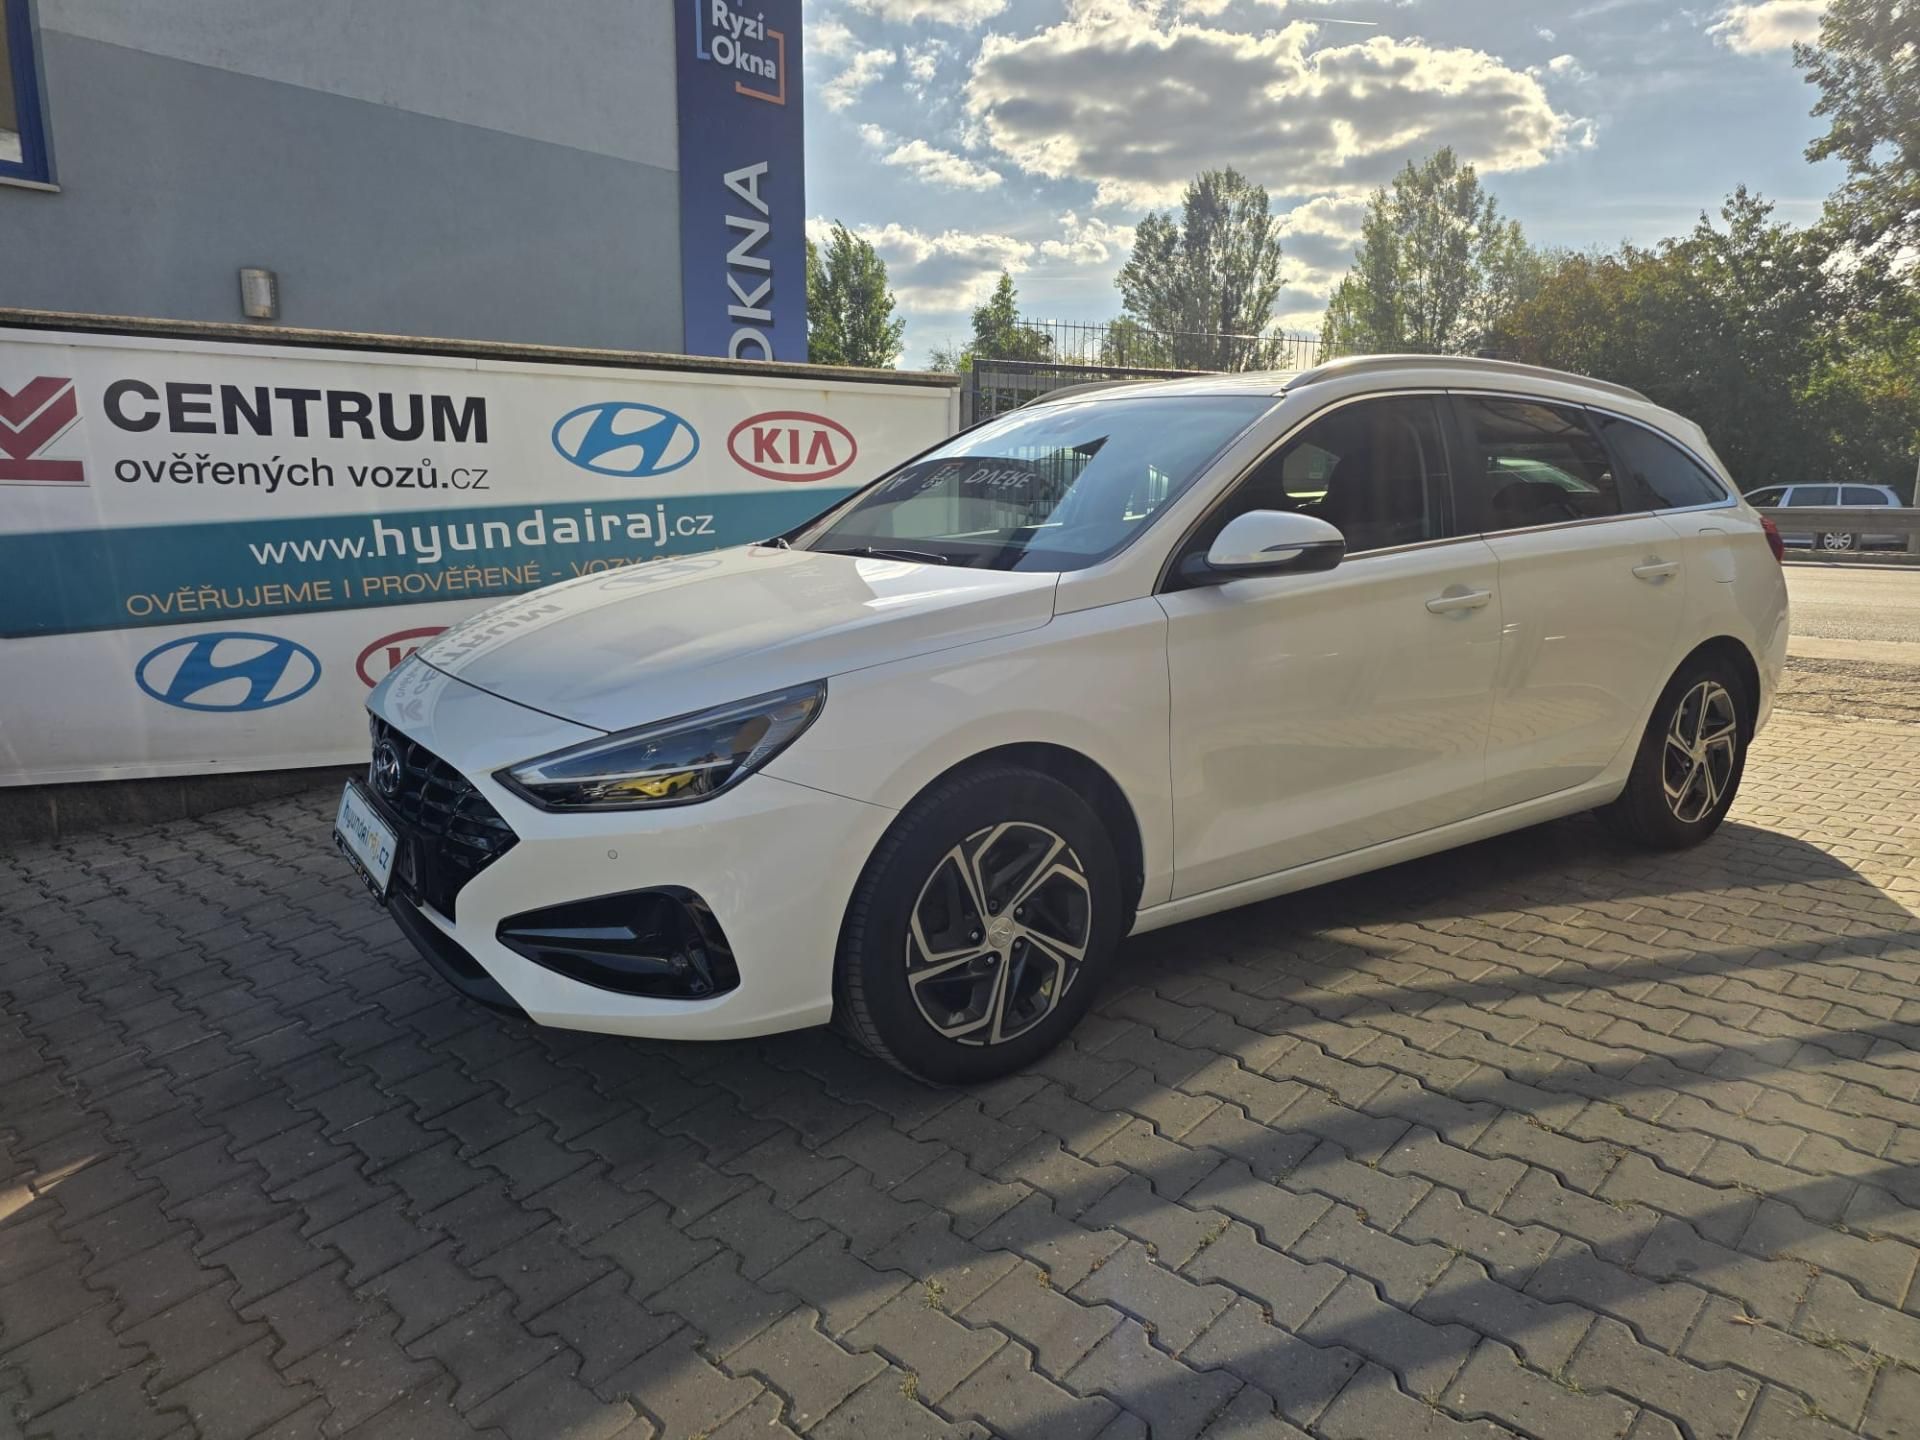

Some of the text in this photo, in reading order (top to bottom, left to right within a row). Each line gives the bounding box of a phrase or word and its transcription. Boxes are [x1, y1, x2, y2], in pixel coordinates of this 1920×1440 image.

[712, 35, 776, 79] Okna
[102, 378, 489, 444] CENTRUM
[752, 427, 837, 466] KIA
[114, 452, 334, 493] ověřených
[248, 504, 716, 566] www.hyundairaj.cz
[126, 580, 333, 616] OVĚŘUJEME
[344, 579, 351, 598] I
[362, 560, 542, 597] PROVĚŘENÉ
